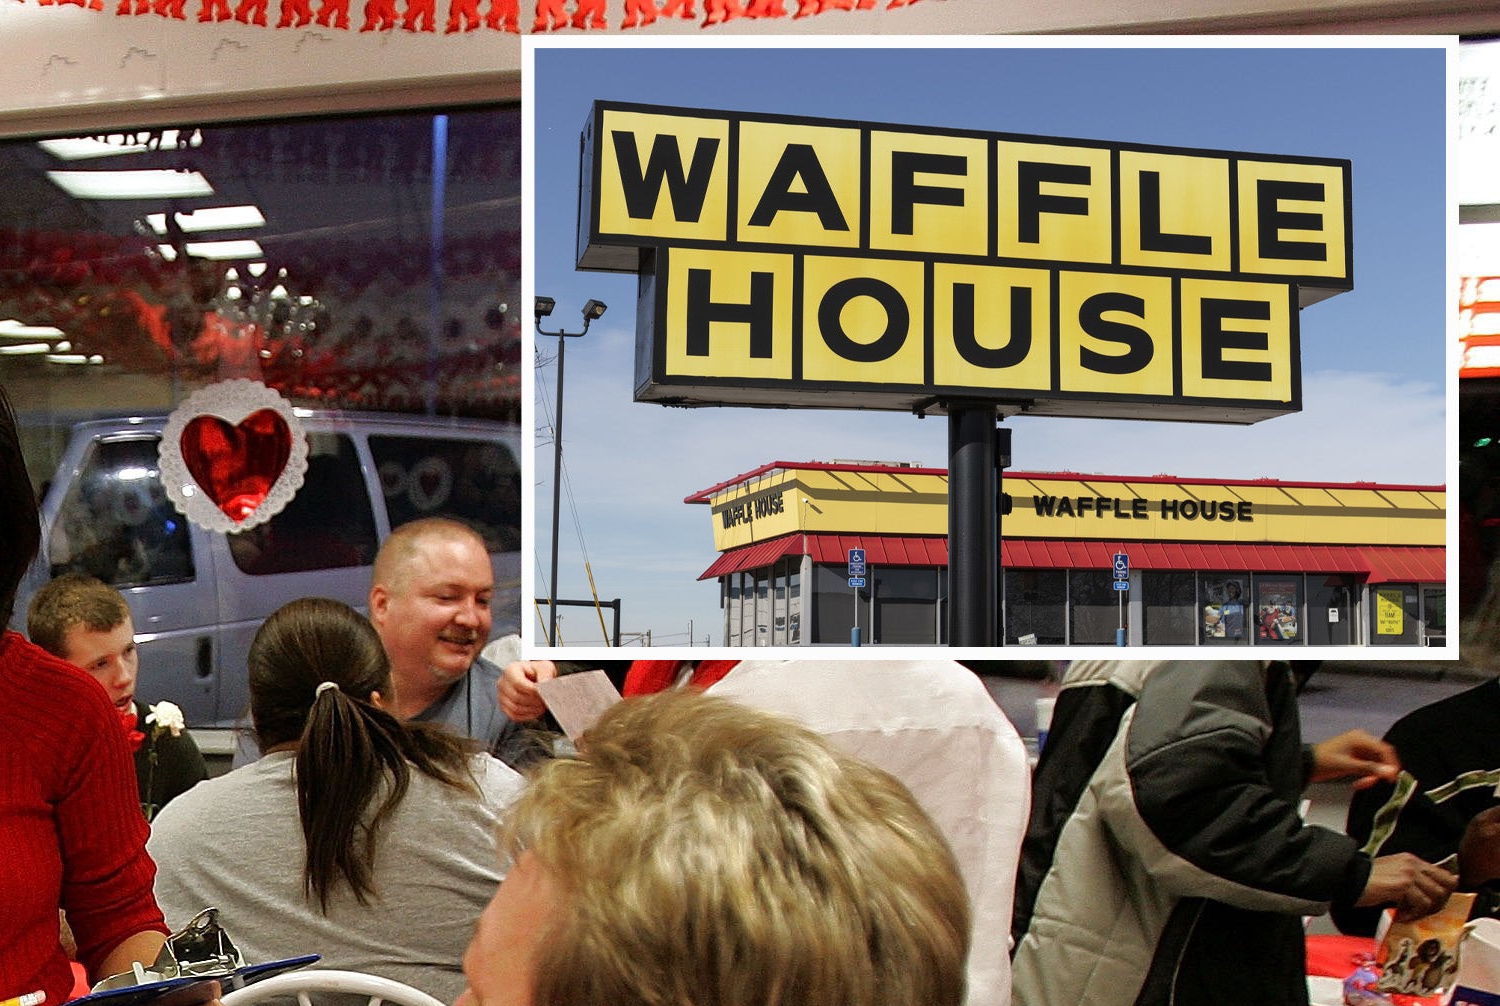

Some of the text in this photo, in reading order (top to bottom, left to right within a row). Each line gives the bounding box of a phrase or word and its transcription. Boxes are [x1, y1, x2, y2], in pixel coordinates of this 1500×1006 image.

[611, 130, 1327, 262] WAFFLE
[686, 268, 1273, 382] HOUSE
[722, 491, 784, 530] WAFFLE HOUSE
[1033, 495, 1253, 522] WAFFLE HOUSE
